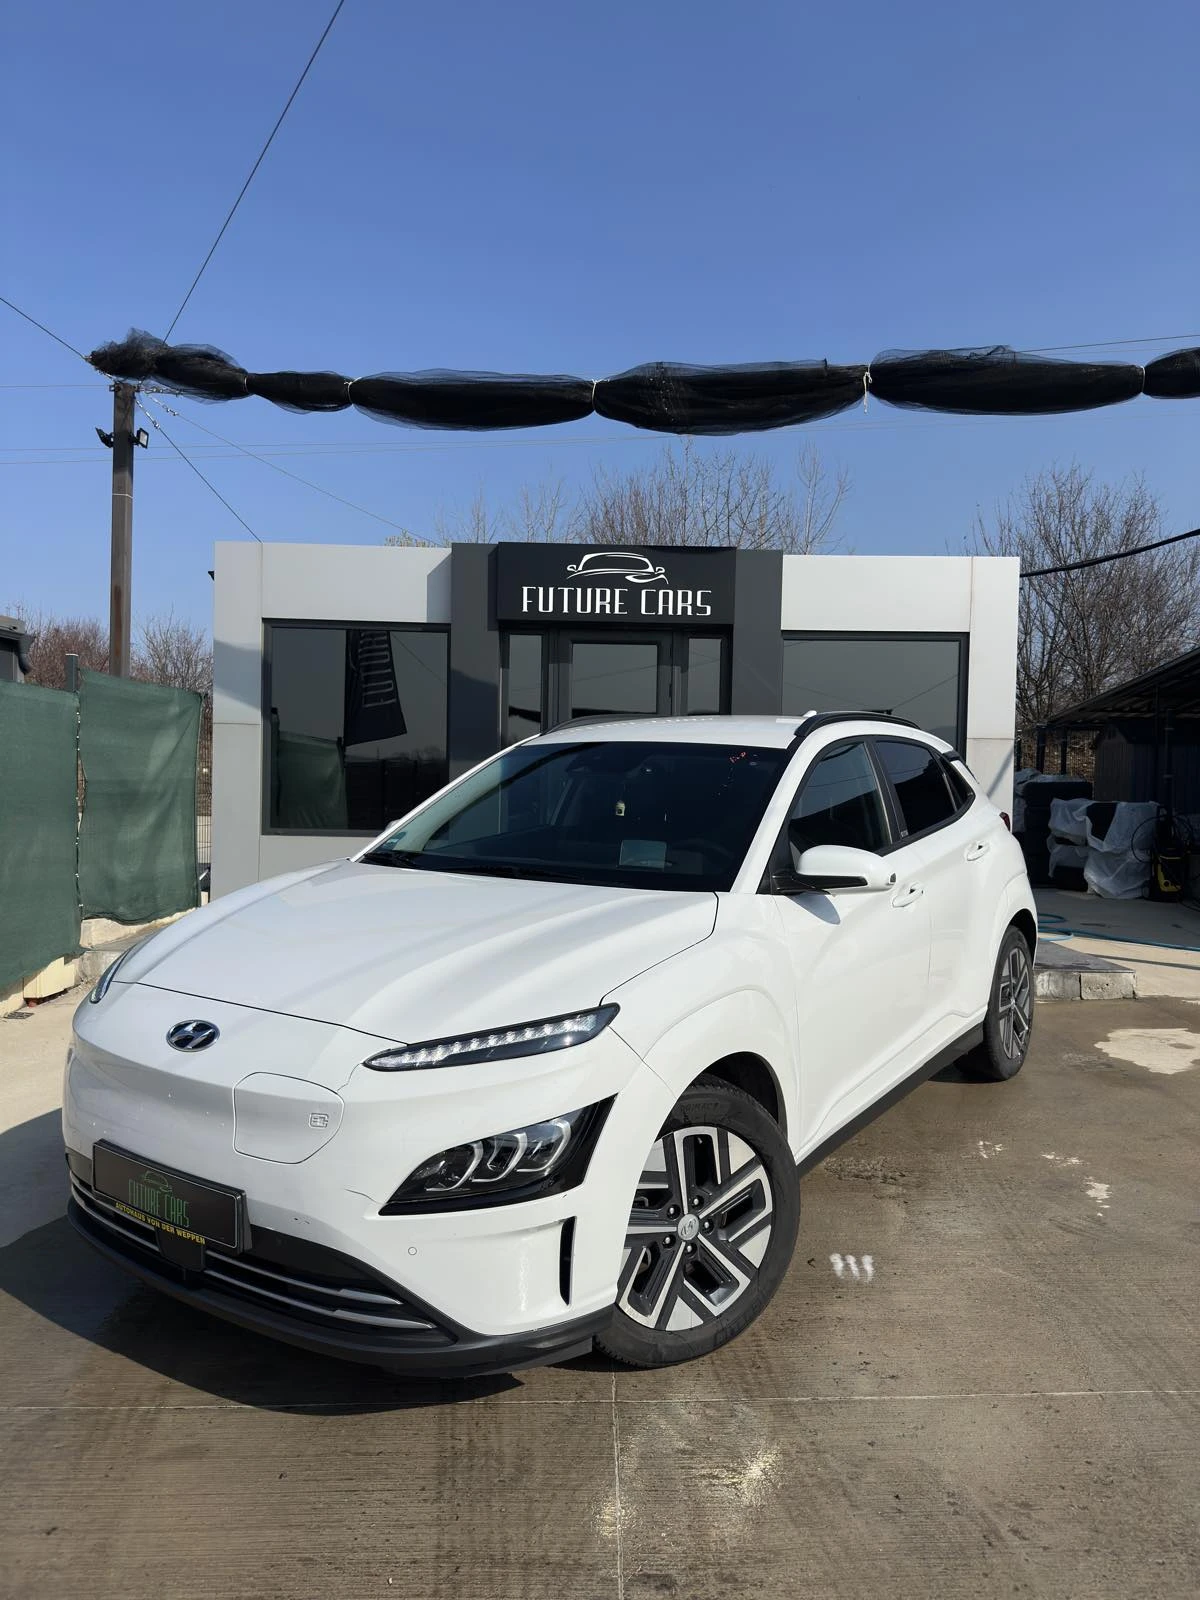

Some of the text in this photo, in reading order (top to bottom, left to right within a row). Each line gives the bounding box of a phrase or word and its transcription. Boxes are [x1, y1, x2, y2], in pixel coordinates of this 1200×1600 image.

[522, 586, 712, 616] FUTURE CARS
[116, 1202, 205, 1244] AUTOHAUS VON DER WEPPEN
[128, 1178, 190, 1228] FUTURE CARS
